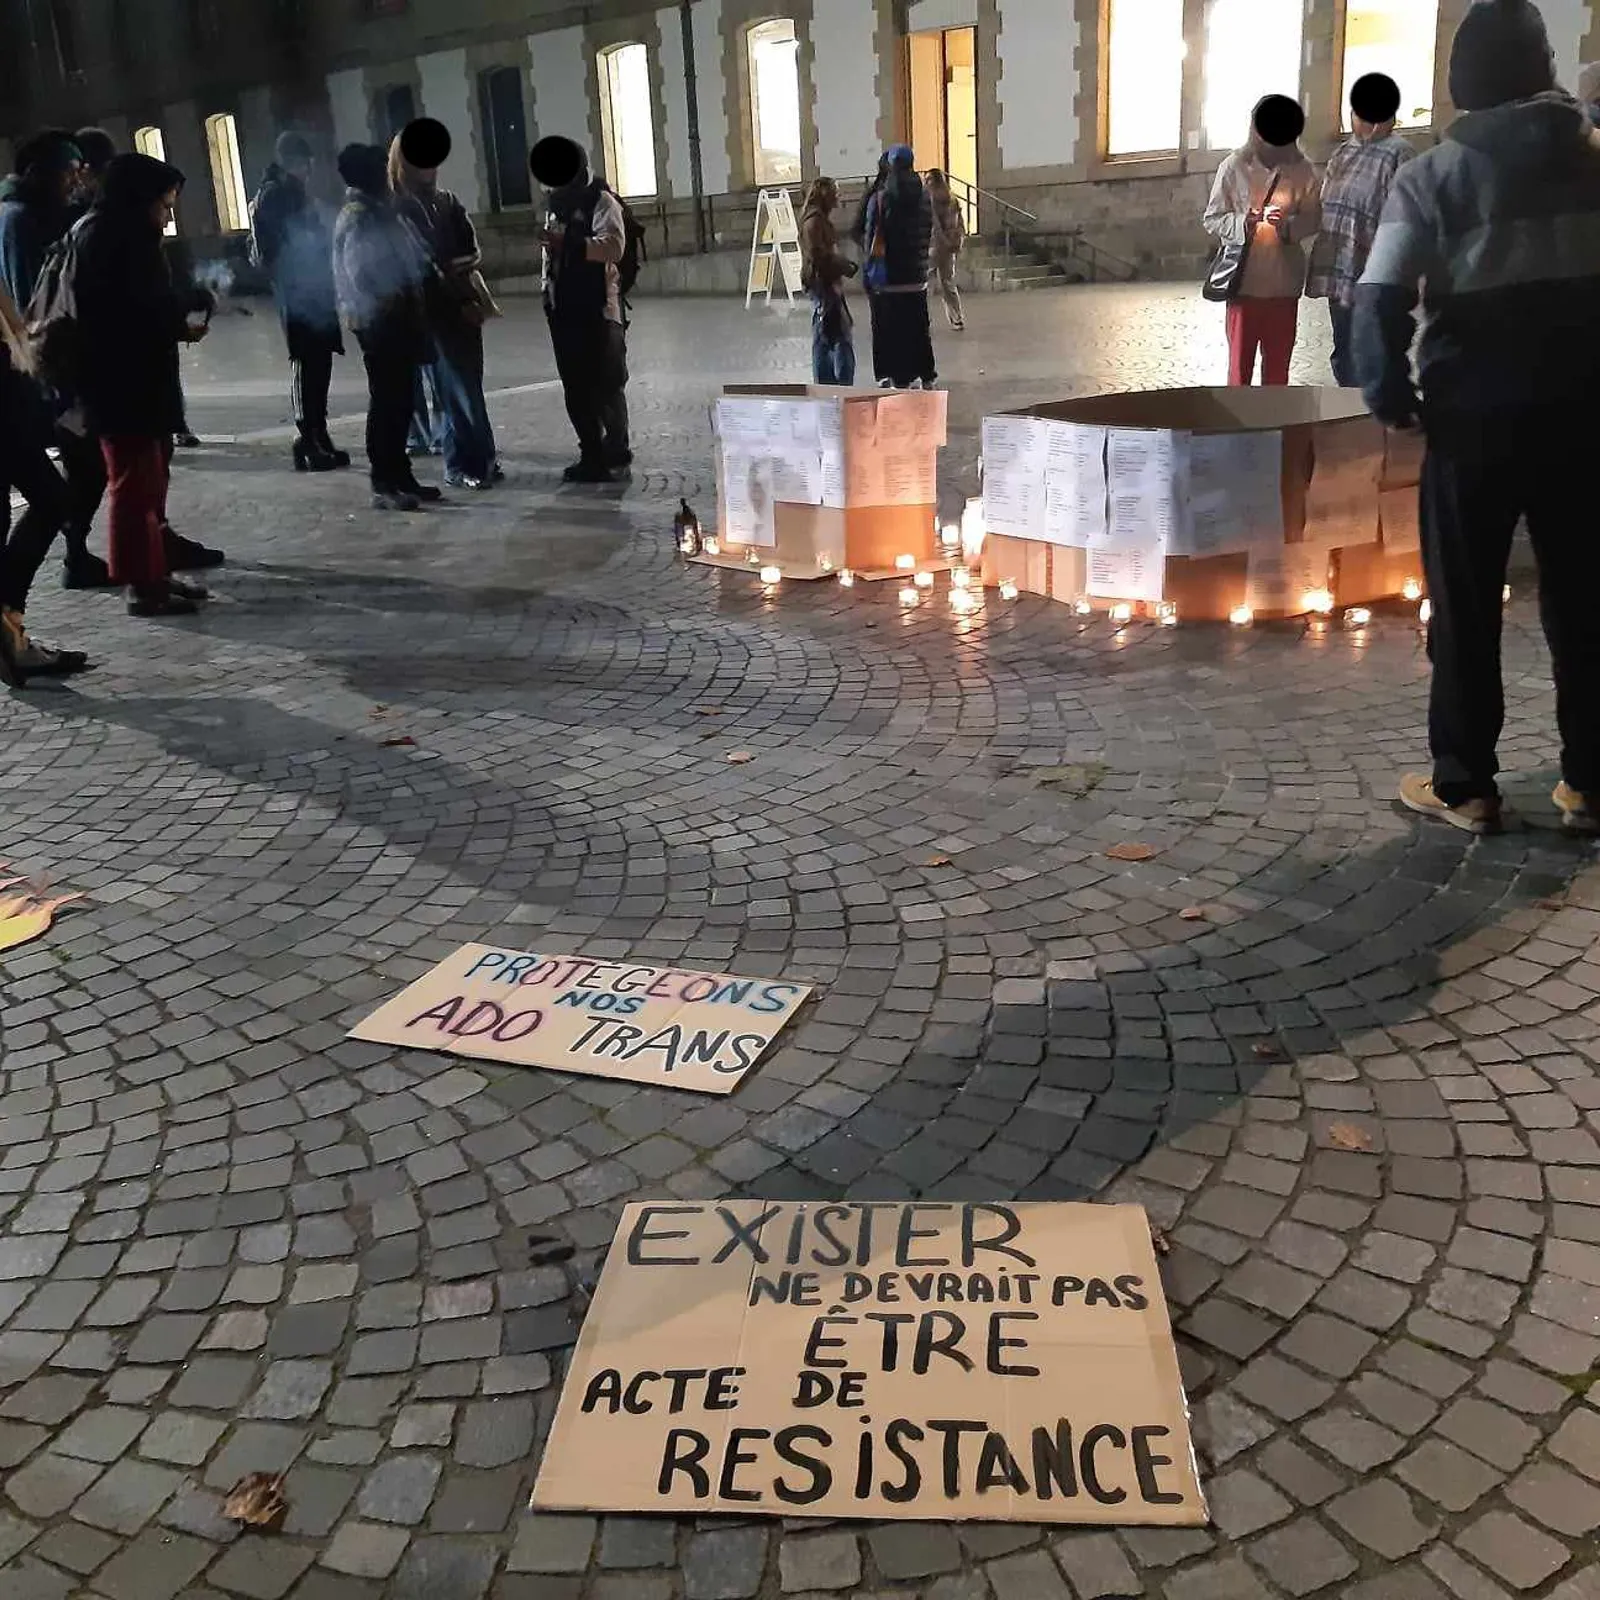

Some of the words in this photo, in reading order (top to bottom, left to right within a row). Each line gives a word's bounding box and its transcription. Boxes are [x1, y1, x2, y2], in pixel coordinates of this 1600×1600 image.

[553, 991, 647, 1013] NOS
[405, 996, 543, 1042] ADO
[568, 1015, 766, 1074] TRANS
[749, 1271, 822, 1306] NE
[1052, 1275, 1148, 1311] PAS
[803, 1305, 1040, 1376] ÊTRE
[580, 1367, 746, 1415] ACTE
[792, 1370, 867, 1408] DE
